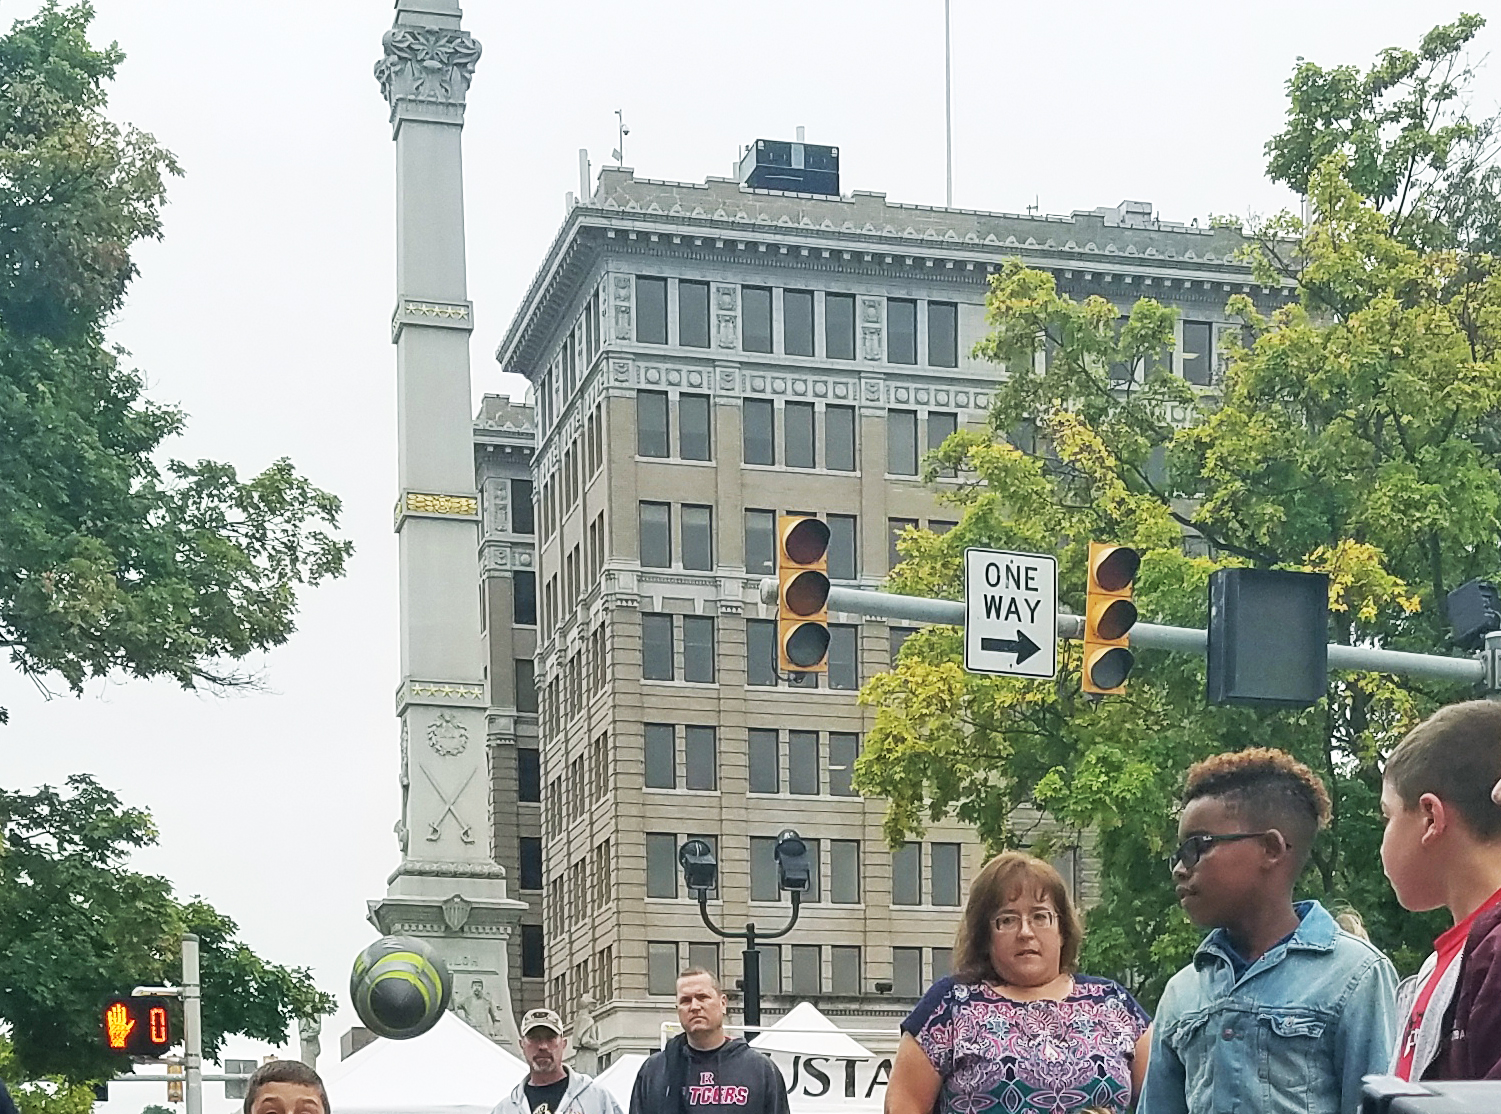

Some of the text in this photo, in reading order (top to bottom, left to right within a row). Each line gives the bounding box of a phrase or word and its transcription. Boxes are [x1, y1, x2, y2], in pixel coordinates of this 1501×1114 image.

[985, 562, 1039, 592] ONE
[983, 594, 1041, 624] WAY
[150, 1007, 167, 1043] 0
[700, 1071, 714, 1085] R
[766, 1053, 892, 1099] USTA
